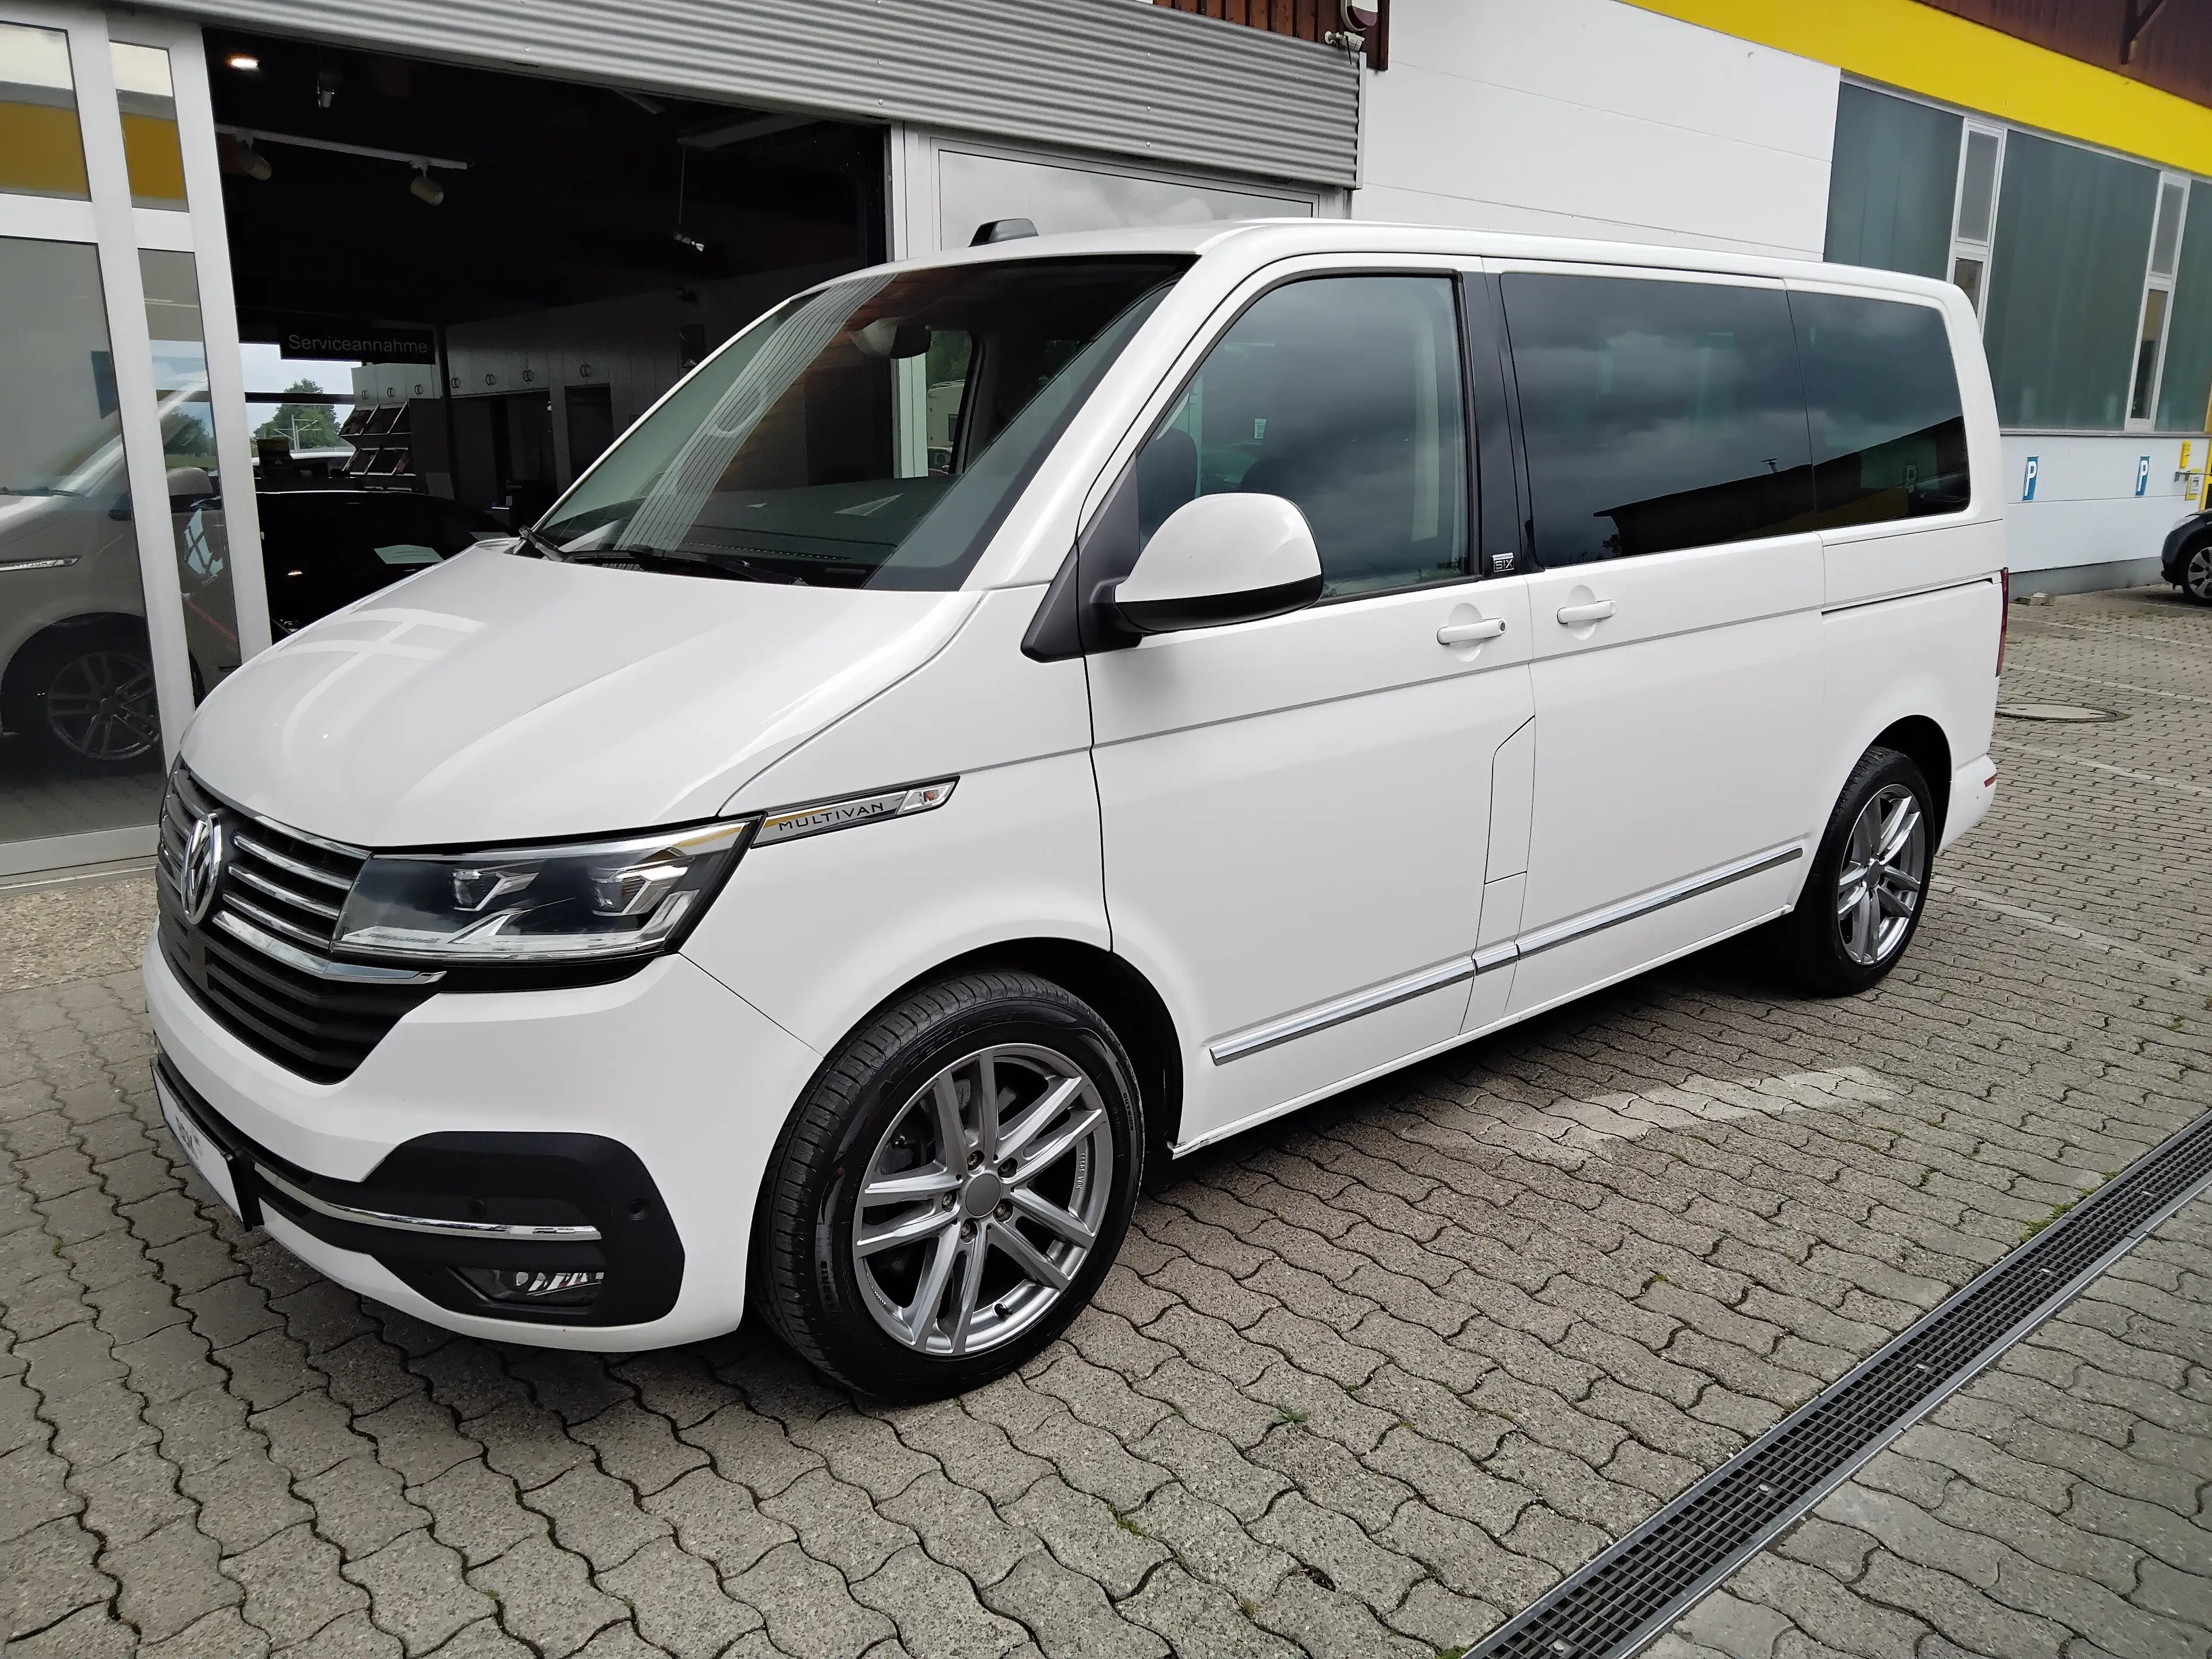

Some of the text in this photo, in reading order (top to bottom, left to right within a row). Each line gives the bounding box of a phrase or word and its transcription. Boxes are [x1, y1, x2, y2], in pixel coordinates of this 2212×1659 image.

[288, 334, 428, 353] Serviceannahme
[2024, 461, 2037, 496] P
[2138, 460, 2148, 492] P
[778, 802, 884, 831] MULTIVAN
